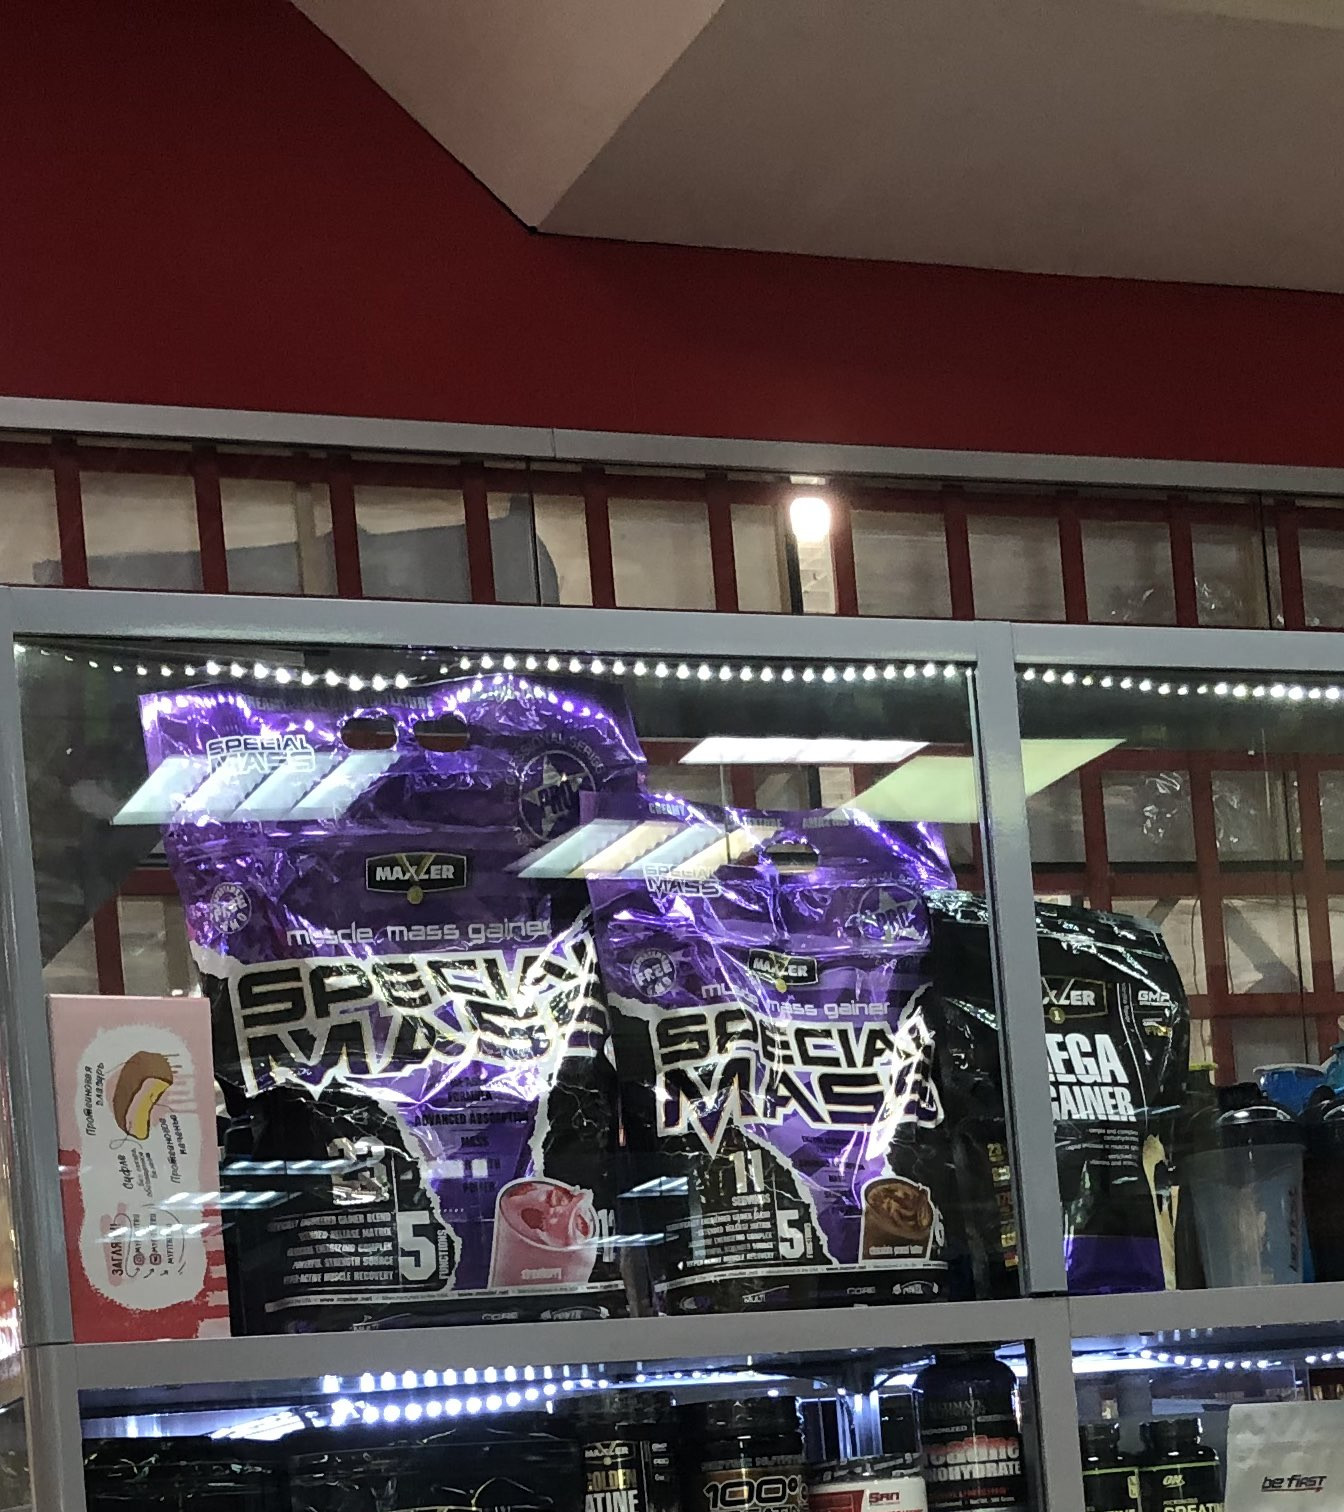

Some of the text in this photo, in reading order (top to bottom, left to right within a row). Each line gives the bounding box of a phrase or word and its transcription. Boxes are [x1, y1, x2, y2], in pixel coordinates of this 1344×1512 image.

[208, 735, 310, 754] SPECIAL
[376, 865, 455, 881] MAXLER
[647, 877, 721, 897] MASS
[388, 921, 460, 942] mass
[754, 957, 808, 977] MAXLER
[825, 1001, 889, 1017] gainer
[415, 1112, 467, 1126] ADVANCED
[779, 1210, 805, 1259] 5
[398, 1212, 436, 1280] 5
[438, 1229, 453, 1279] FUNCTIONS
[584, 1444, 628, 1458] MAXLER
